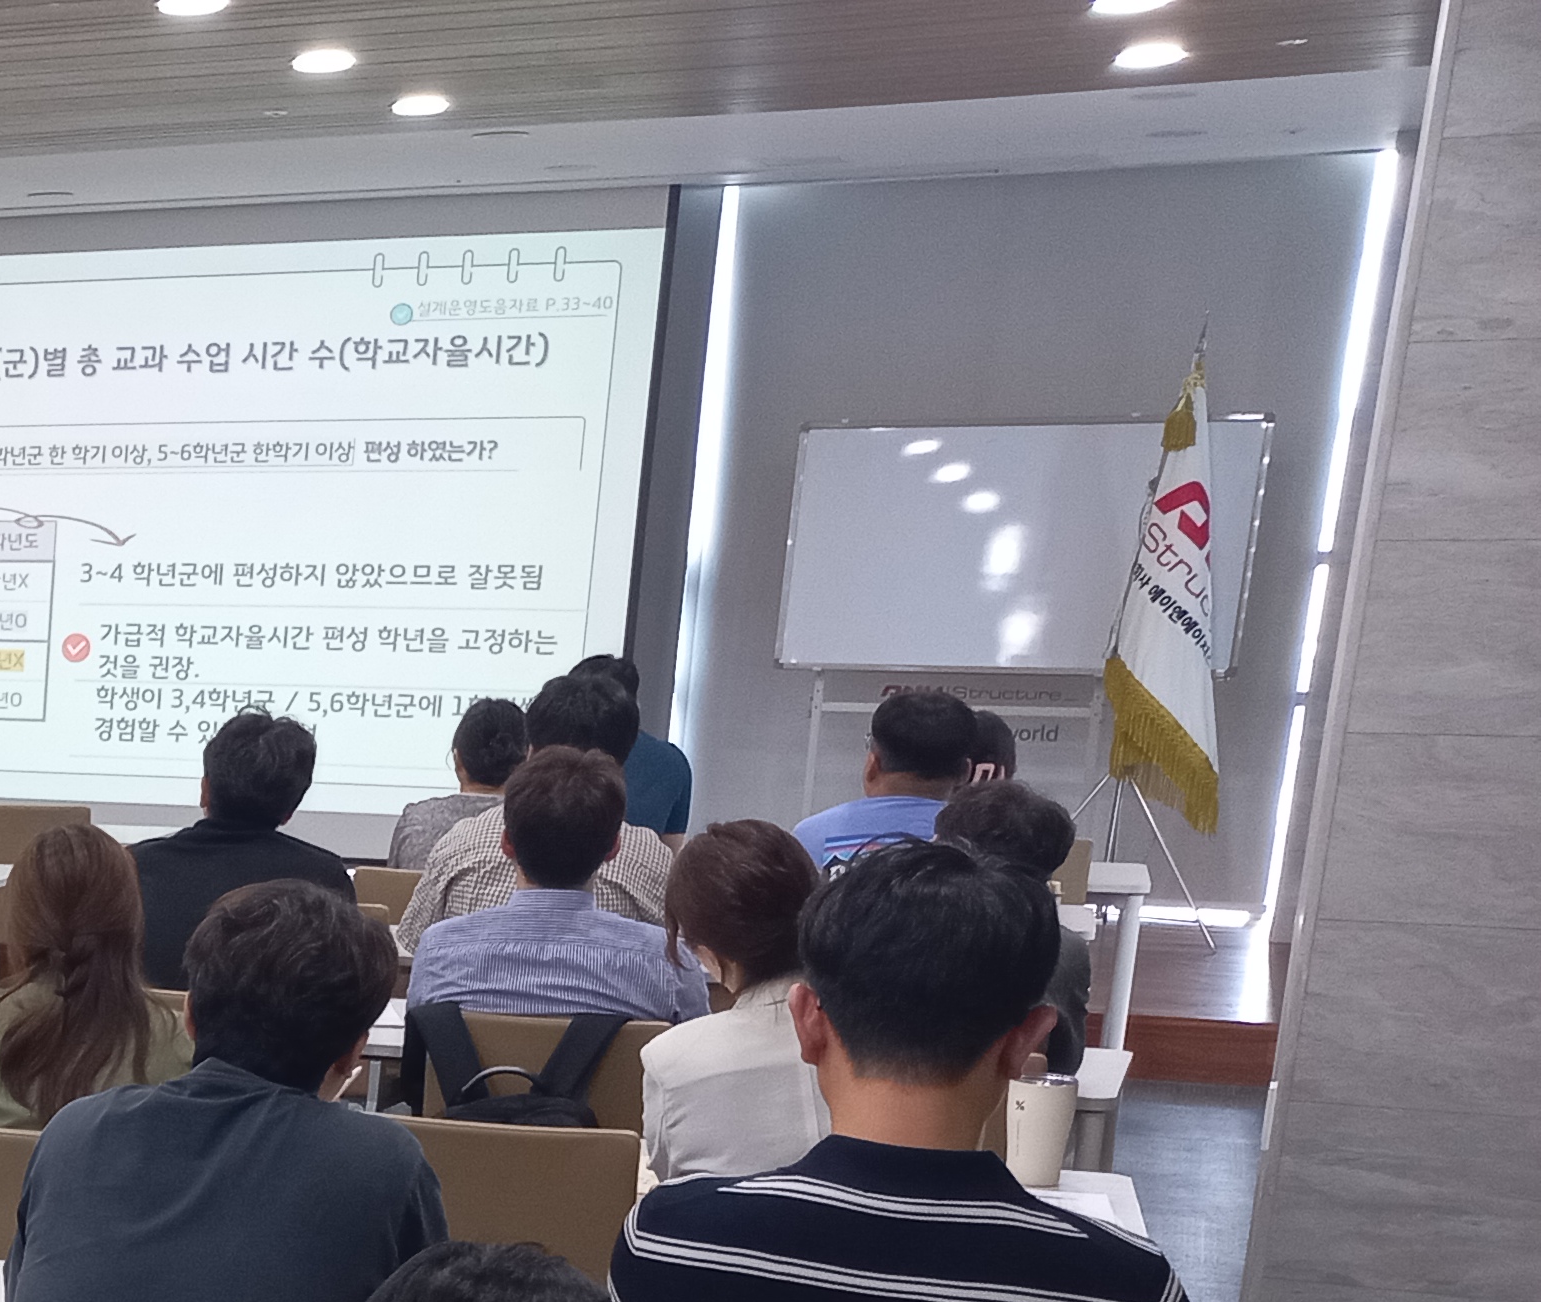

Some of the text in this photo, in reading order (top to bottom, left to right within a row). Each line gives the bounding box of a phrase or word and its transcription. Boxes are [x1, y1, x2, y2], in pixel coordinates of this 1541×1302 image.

[418, 295, 614, 317] 설계운영도움자료 P.33~40
[76, 344, 102, 377] 총
[112, 343, 168, 373] 교과
[176, 342, 231, 374] 수업
[241, 340, 298, 372] 시간
[308, 332, 550, 370] 수(학교자율시간)
[48, 444, 67, 466] 한
[71, 443, 108, 465] 학기
[112, 443, 152, 466] 이상,
[157, 442, 248, 464] 5~6학년군
[253, 441, 310, 462] 한학기
[315, 441, 354, 462] 이상
[363, 440, 402, 463] 편성
[407, 439, 499, 463] 하였는가?
[79, 561, 544, 591] 3~4 학년군에 편성하지 않았으므로 잘못됨
[99, 622, 558, 656] 가급적 학교자율시간 편성 학년을 고정하는
[98, 654, 200, 681] 것을 권장.
[96, 685, 162, 711] 학생이
[308, 691, 443, 719] 5,6학년군에
[95, 716, 160, 743] 경험할
[166, 719, 189, 742] 수
